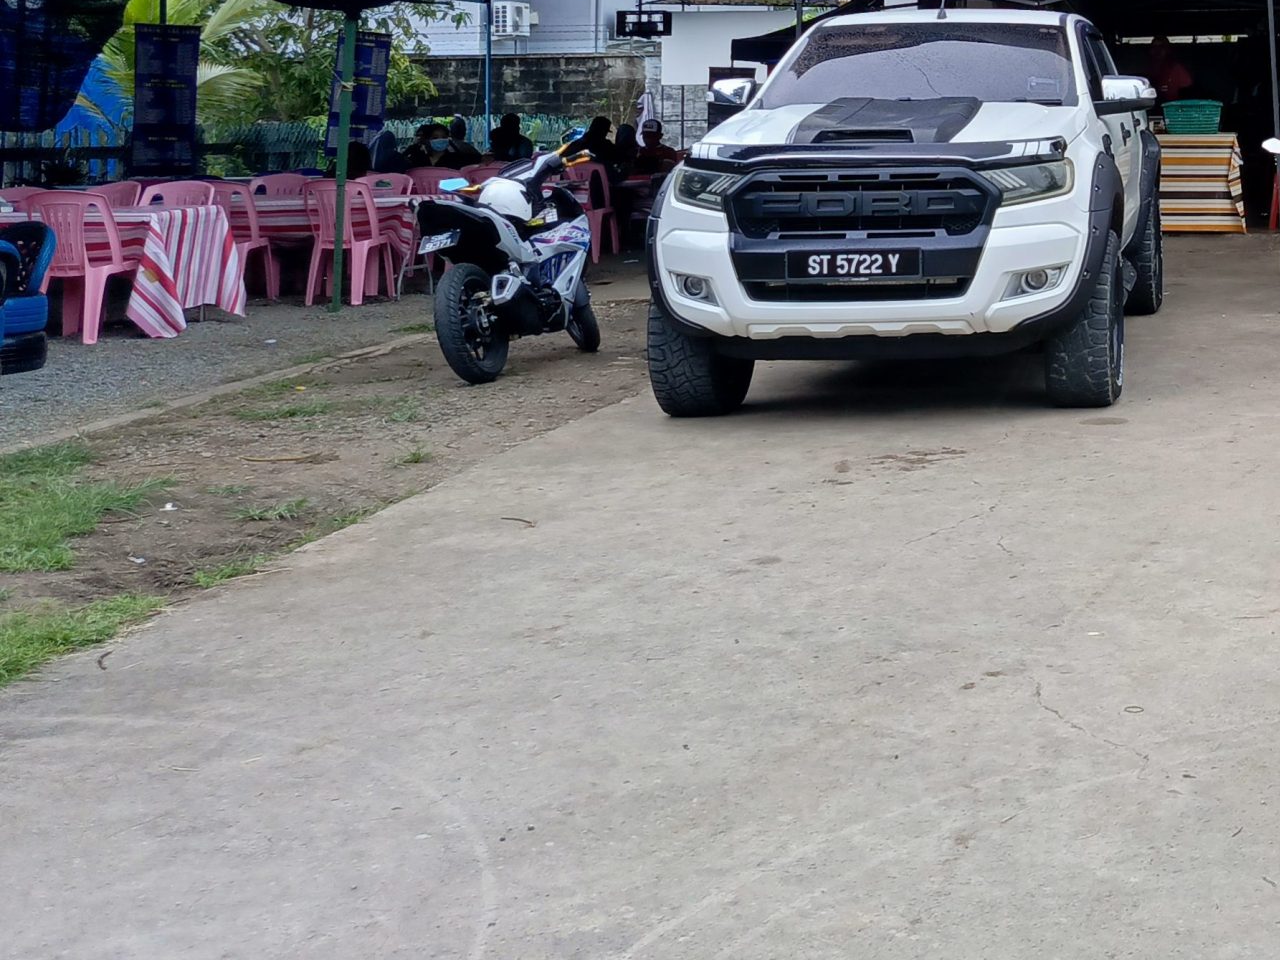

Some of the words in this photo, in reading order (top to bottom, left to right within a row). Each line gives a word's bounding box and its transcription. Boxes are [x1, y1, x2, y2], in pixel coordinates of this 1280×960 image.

[807, 255, 832, 275] ST
[836, 254, 883, 275] 5722
[888, 253, 900, 273] Y
